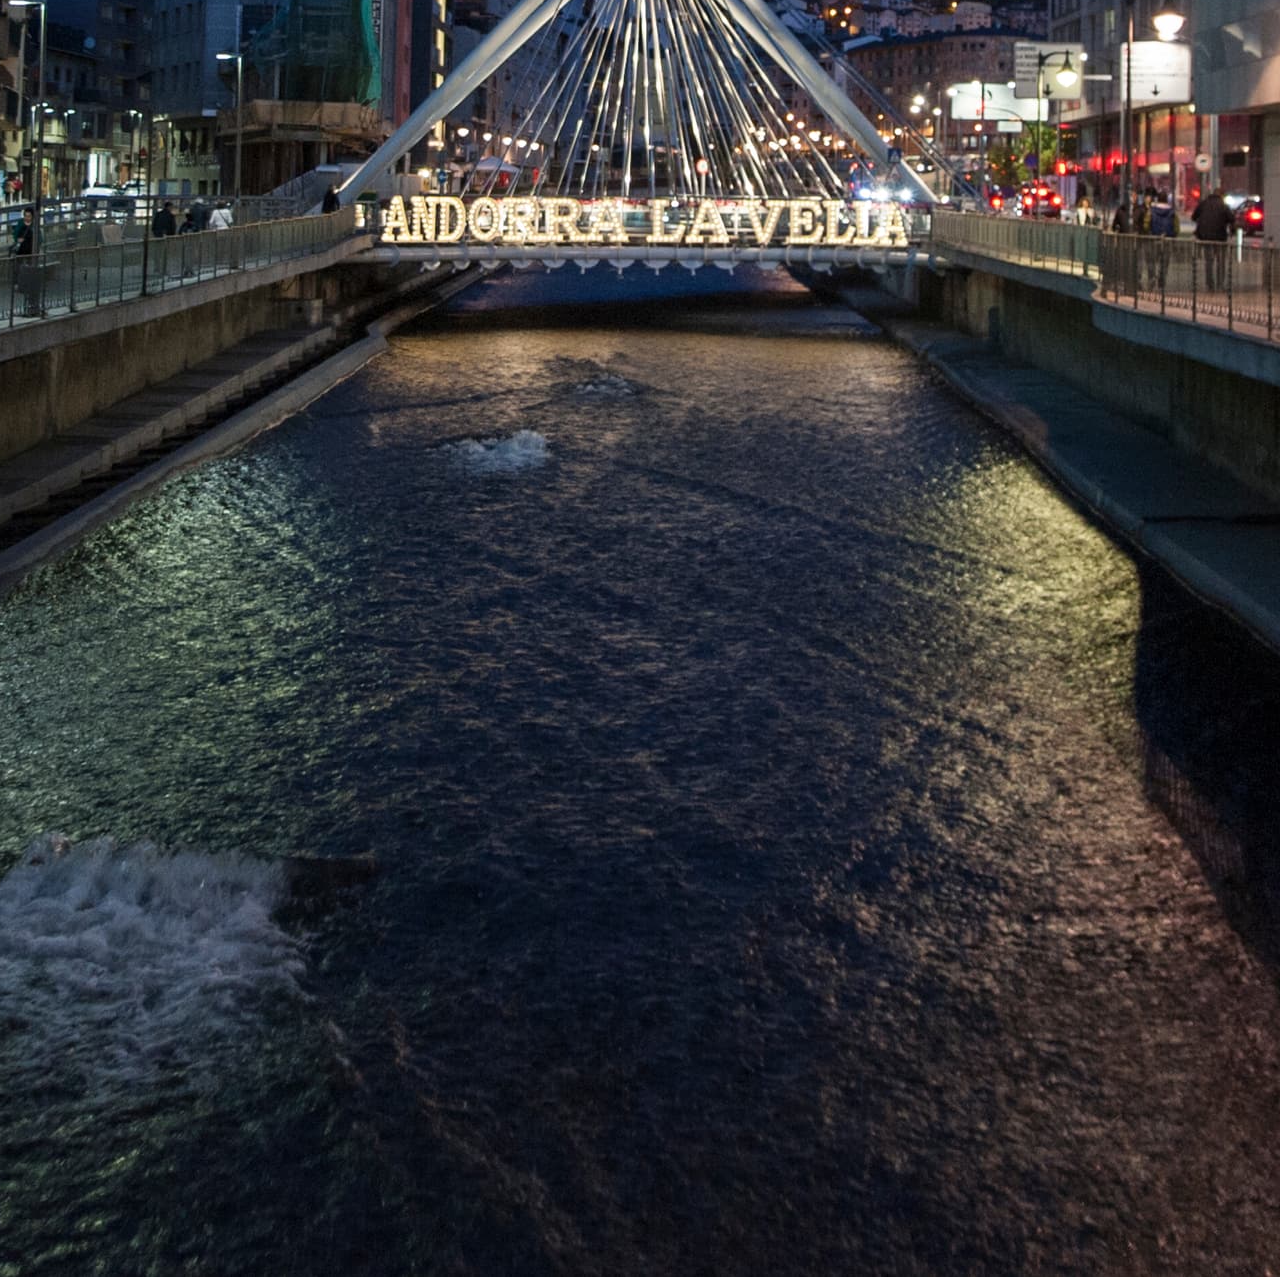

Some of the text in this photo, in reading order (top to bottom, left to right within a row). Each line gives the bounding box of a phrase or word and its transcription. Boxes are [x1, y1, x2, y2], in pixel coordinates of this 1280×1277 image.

[381, 194, 908, 246] ANDORRA LA VELLA
